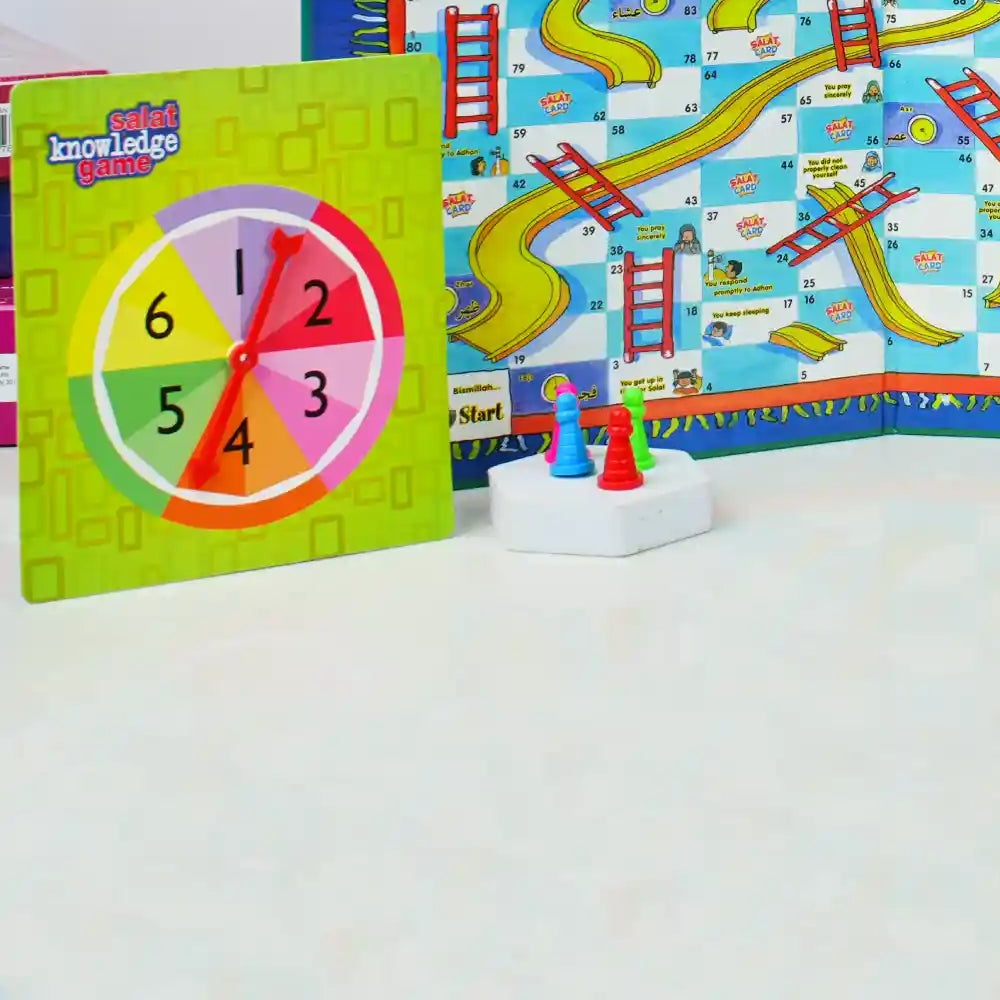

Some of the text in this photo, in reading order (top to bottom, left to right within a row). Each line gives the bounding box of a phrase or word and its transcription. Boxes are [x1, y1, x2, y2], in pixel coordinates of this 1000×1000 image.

[683, 5, 697, 16] 83
[885, 14, 897, 24] 75
[750, 35, 779, 48] SALAT
[753, 45, 778, 55] CARD
[684, 53, 697, 64] 78
[888, 59, 902, 69] 66
[512, 63, 526, 74] 79
[824, 83, 852, 91] You pray
[799, 95, 812, 106] 65
[824, 91, 852, 99] sincerely
[110, 103, 178, 131] salat
[780, 113, 793, 124] 57
[513, 128, 527, 139] 59
[49, 129, 179, 161] knowledge
[866, 135, 879, 146] 56
[957, 135, 970, 146] 55
[77, 154, 152, 186] game
[780, 160, 794, 170] 44
[802, 165, 830, 173] properly
[812, 171, 839, 179] yourself
[512, 178, 526, 189] 42
[853, 178, 867, 189] 45
[981, 183, 994, 193] 47
[684, 195, 698, 206] 43
[706, 211, 719, 222] 37
[887, 222, 899, 232] 35
[980, 228, 994, 239] 34
[887, 239, 899, 250] 26
[913, 253, 943, 264] SALAT
[234, 247, 245, 296] 1
[610, 264, 624, 275] 23
[918, 262, 942, 270] CARD
[982, 274, 994, 284] 27
[962, 288, 973, 299] 15
[303, 279, 333, 328] 2
[783, 298, 793, 309] 17
[145, 291, 174, 339] 6
[724, 310, 742, 318] keep
[742, 308, 770, 316] sleeping
[513, 354, 526, 365] 19
[983, 362, 990, 372] 7
[303, 370, 329, 418] 3
[158, 384, 185, 435] 5
[459, 402, 504, 424] Start
[223, 417, 255, 465] 4
